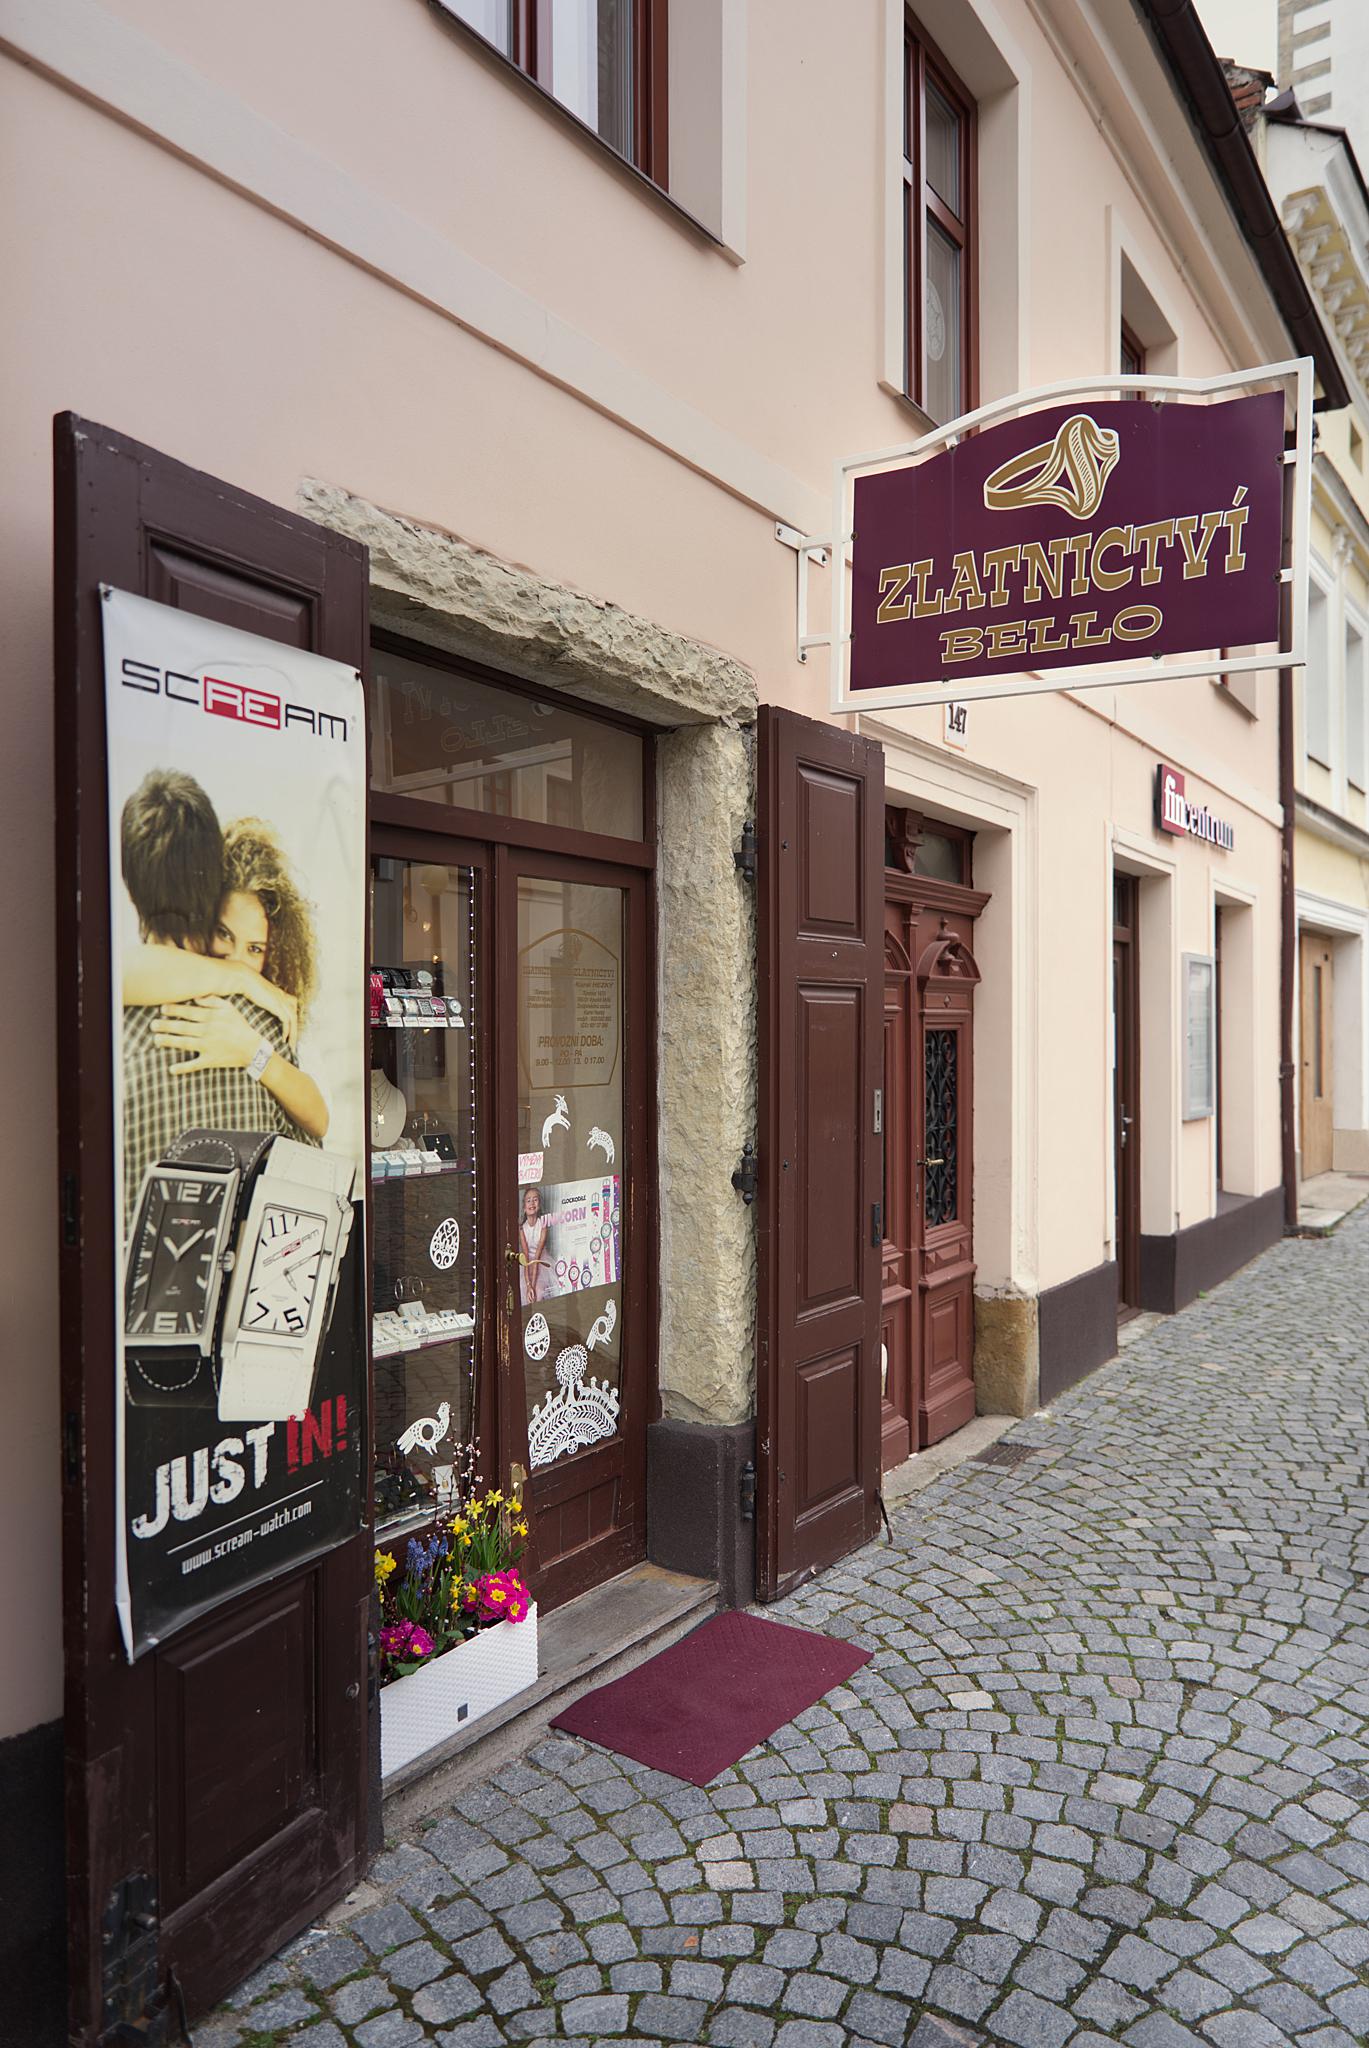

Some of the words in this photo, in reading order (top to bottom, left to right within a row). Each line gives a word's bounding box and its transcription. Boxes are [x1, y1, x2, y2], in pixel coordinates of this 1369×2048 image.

[876, 485, 1250, 624] ZLATNICTVÍ
[939, 604, 1163, 664] BELLO
[121, 658, 348, 742] SCREAM
[948, 704, 967, 734] 147
[1163, 774, 1235, 850] fincentrum
[539, 1032, 579, 1047] PROVOZNÍ
[581, 1035, 604, 1046] DOBA:
[540, 1206, 587, 1228] UNICORN
[131, 1421, 276, 1540] JUST
[286, 1394, 348, 1476] IN!
[181, 1500, 312, 1575] www.scream-watch.com
